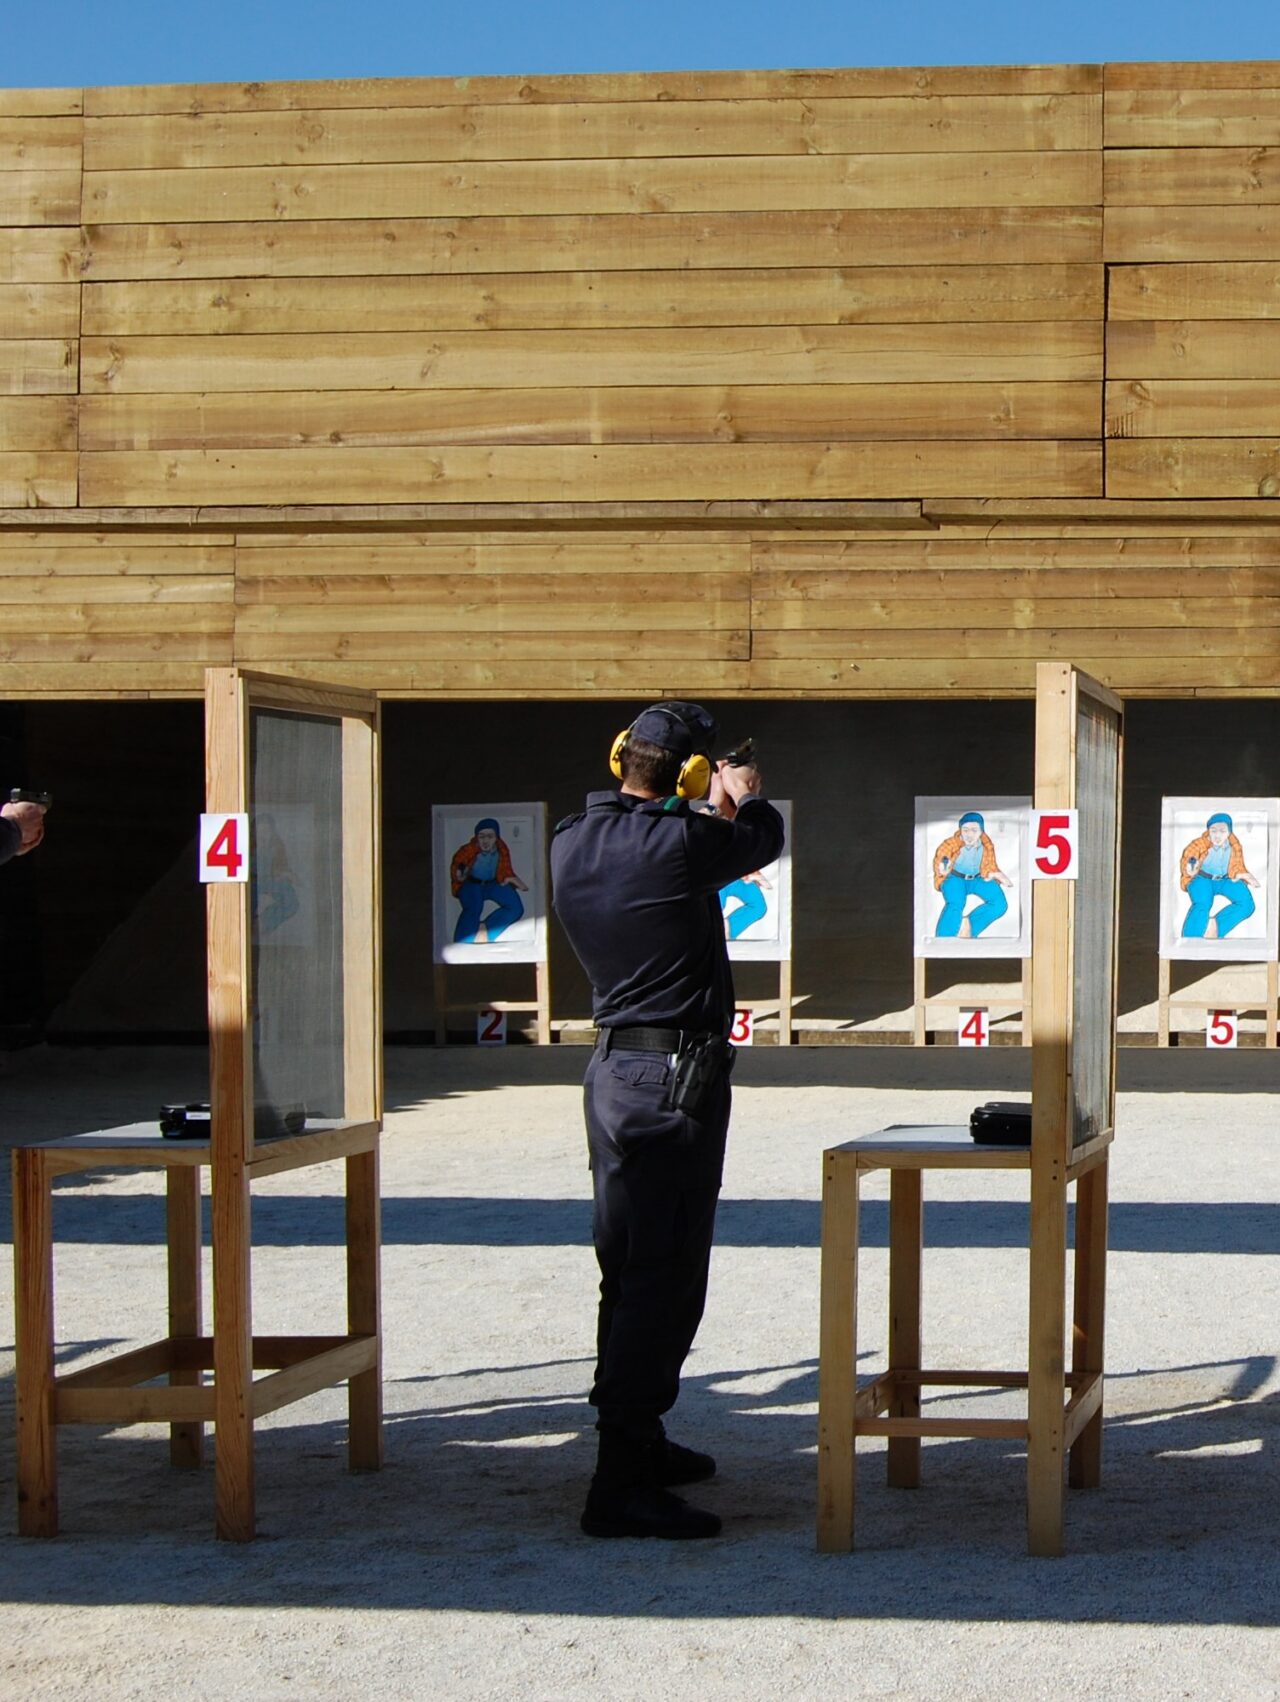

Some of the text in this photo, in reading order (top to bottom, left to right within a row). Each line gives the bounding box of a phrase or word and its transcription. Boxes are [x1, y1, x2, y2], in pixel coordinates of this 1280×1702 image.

[207, 818, 242, 877] 4
[1035, 815, 1071, 875] 5
[480, 1010, 503, 1041] 2
[729, 1009, 750, 1041] 3
[961, 1011, 986, 1045] 4
[1211, 1010, 1234, 1045] 5
